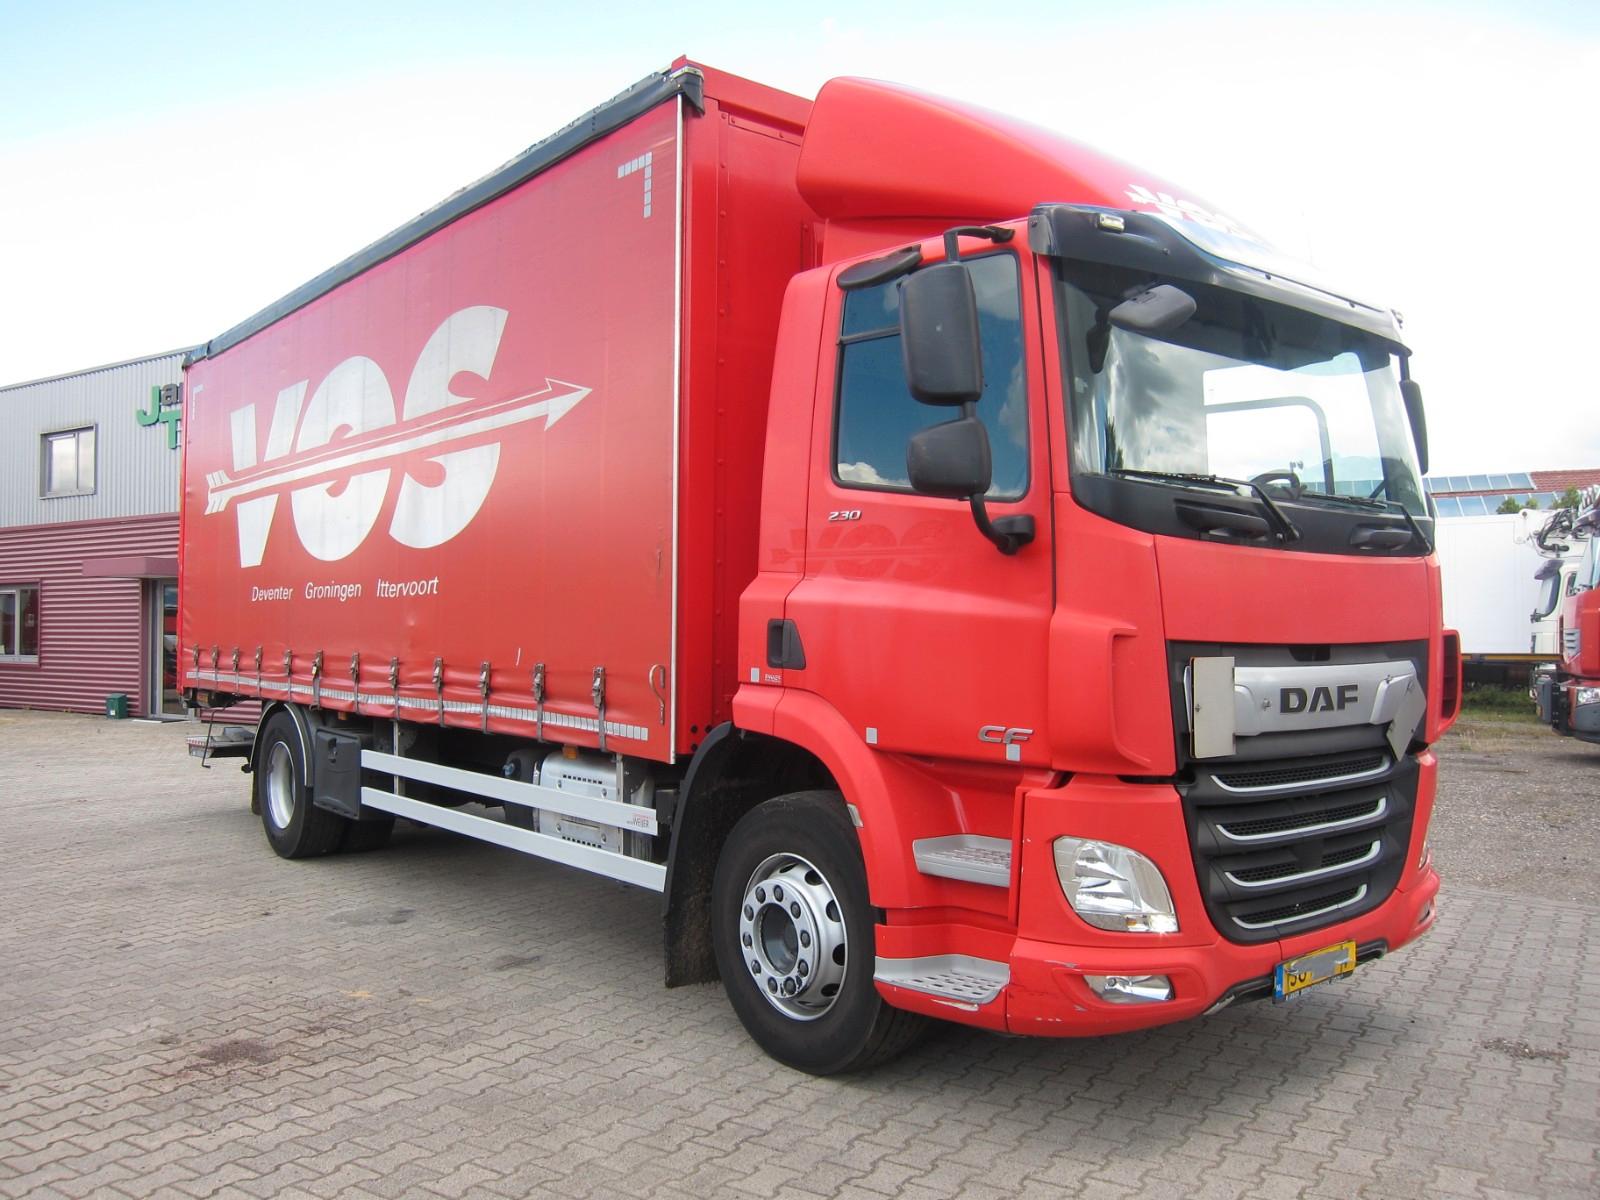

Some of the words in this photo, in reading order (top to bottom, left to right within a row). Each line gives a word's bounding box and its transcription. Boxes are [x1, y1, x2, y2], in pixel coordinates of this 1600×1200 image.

[229, 305, 510, 569] VOS
[828, 510, 862, 521] 230
[251, 586, 293, 602] Deventer
[305, 580, 362, 602] Groningen
[376, 576, 440, 598] Ittervoort
[1279, 684, 1359, 714] DAF
[977, 725, 1034, 744] CF
